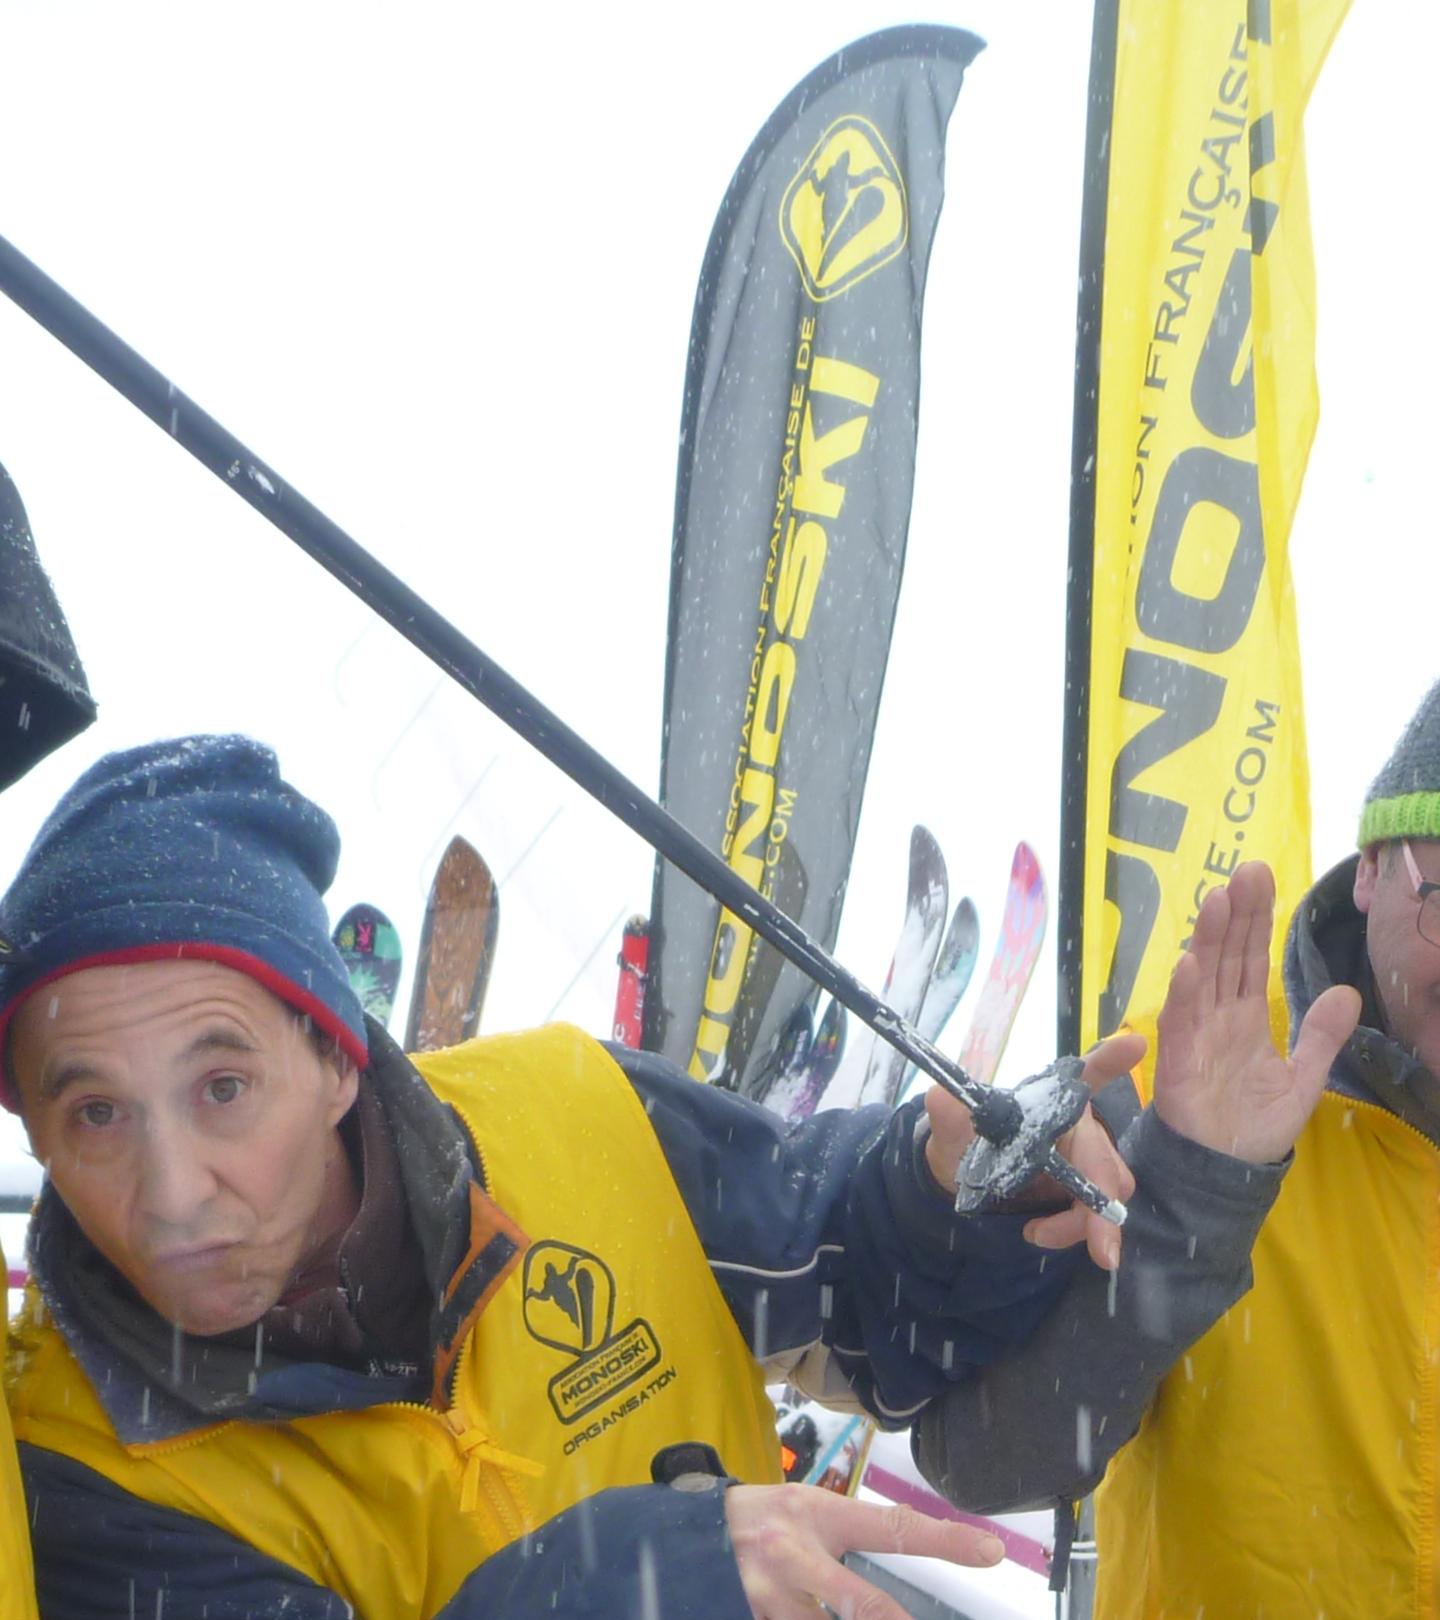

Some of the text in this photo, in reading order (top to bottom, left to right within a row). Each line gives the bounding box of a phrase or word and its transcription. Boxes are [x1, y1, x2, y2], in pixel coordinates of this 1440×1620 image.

[722, 626, 766, 862] SSOCIATION
[796, 317, 816, 371] DE
[561, 1338, 650, 1406] MONOSKI
[562, 1365, 678, 1457] ORGANISATION
